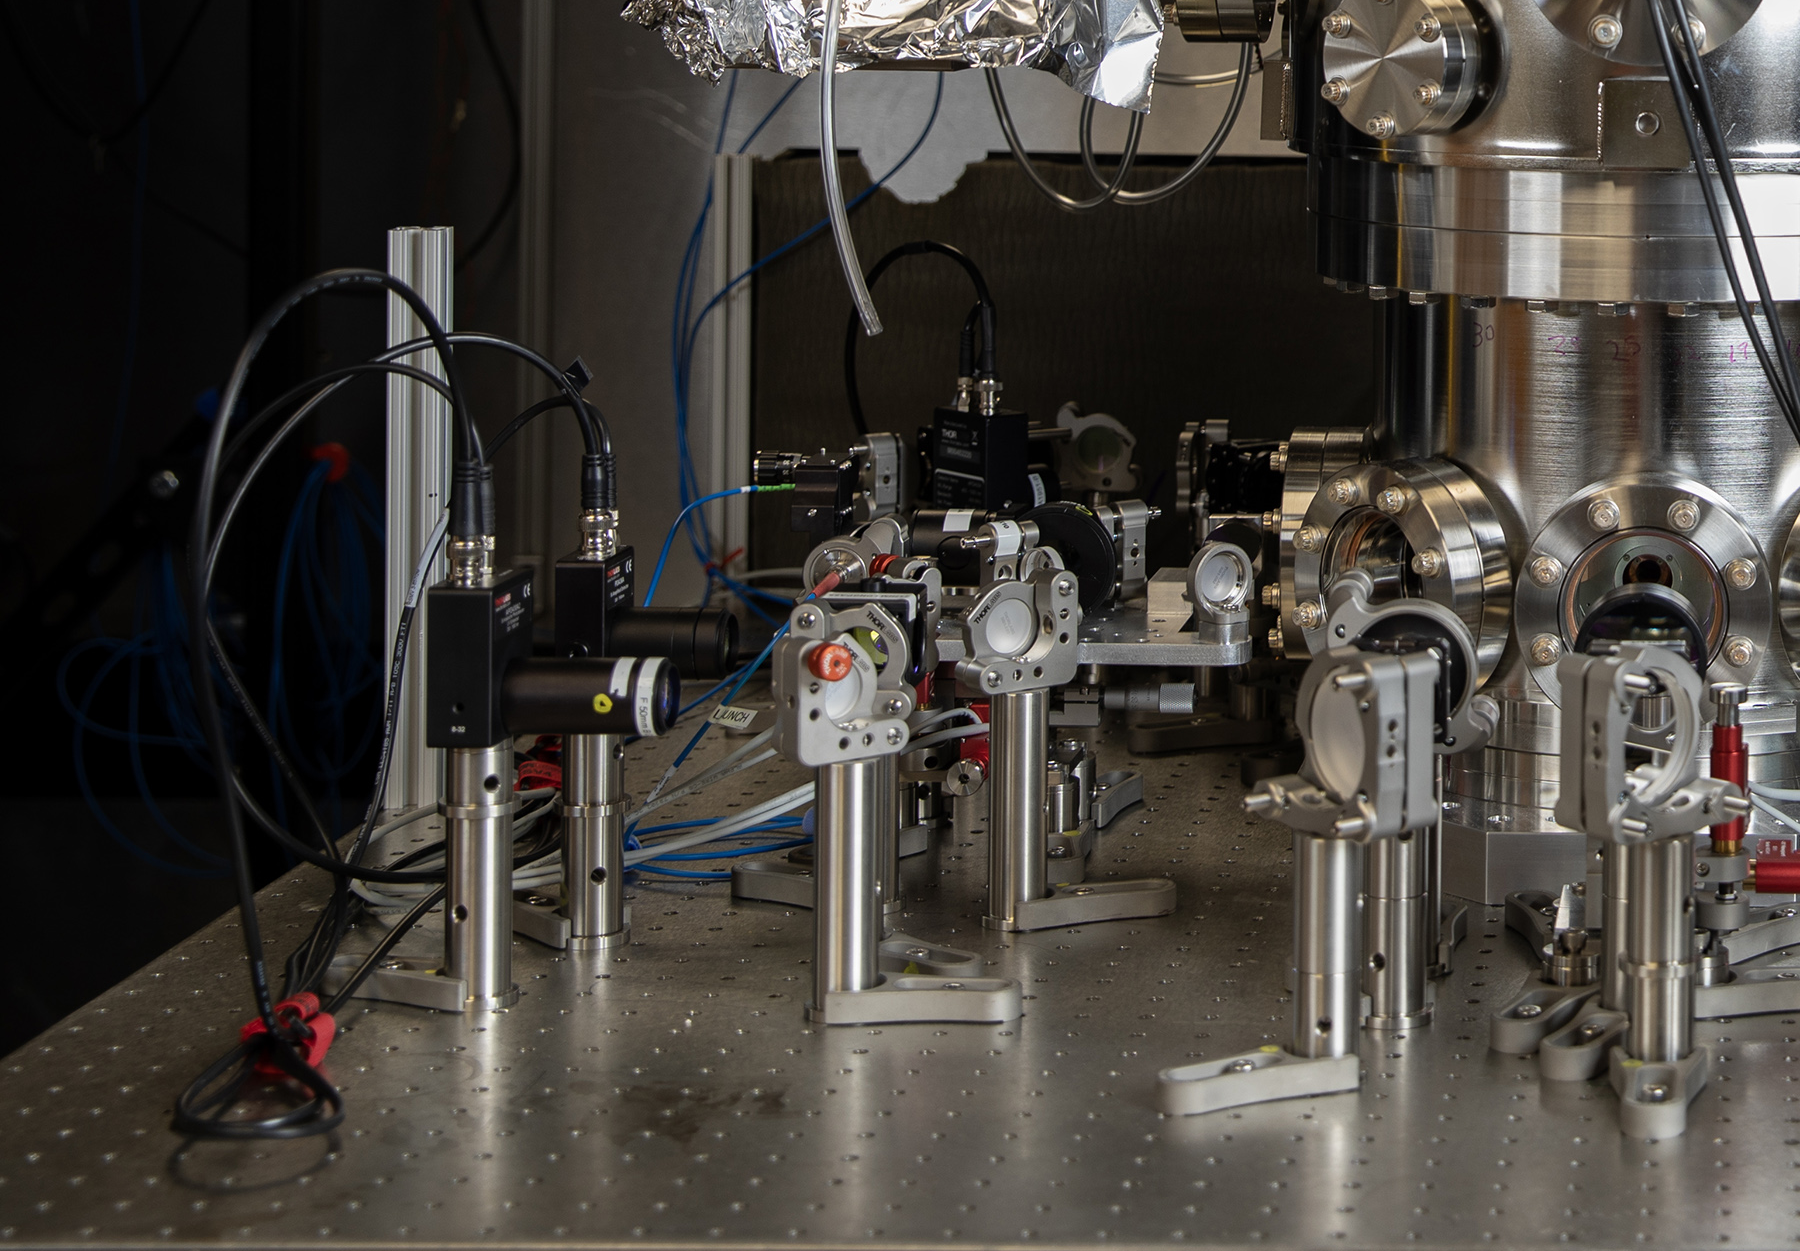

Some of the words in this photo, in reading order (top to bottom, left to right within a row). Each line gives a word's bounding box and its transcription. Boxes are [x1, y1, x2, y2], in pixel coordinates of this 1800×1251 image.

[1472, 322, 1495, 348] 30
[1606, 335, 1642, 362] 25
[1729, 341, 1749, 363] 19
[973, 590, 1002, 625] THORLABS
[866, 610, 899, 644] THORLABS
[392, 660, 401, 679] 105C
[639, 707, 648, 730] 50mm
[713, 708, 750, 723] LUNCH
